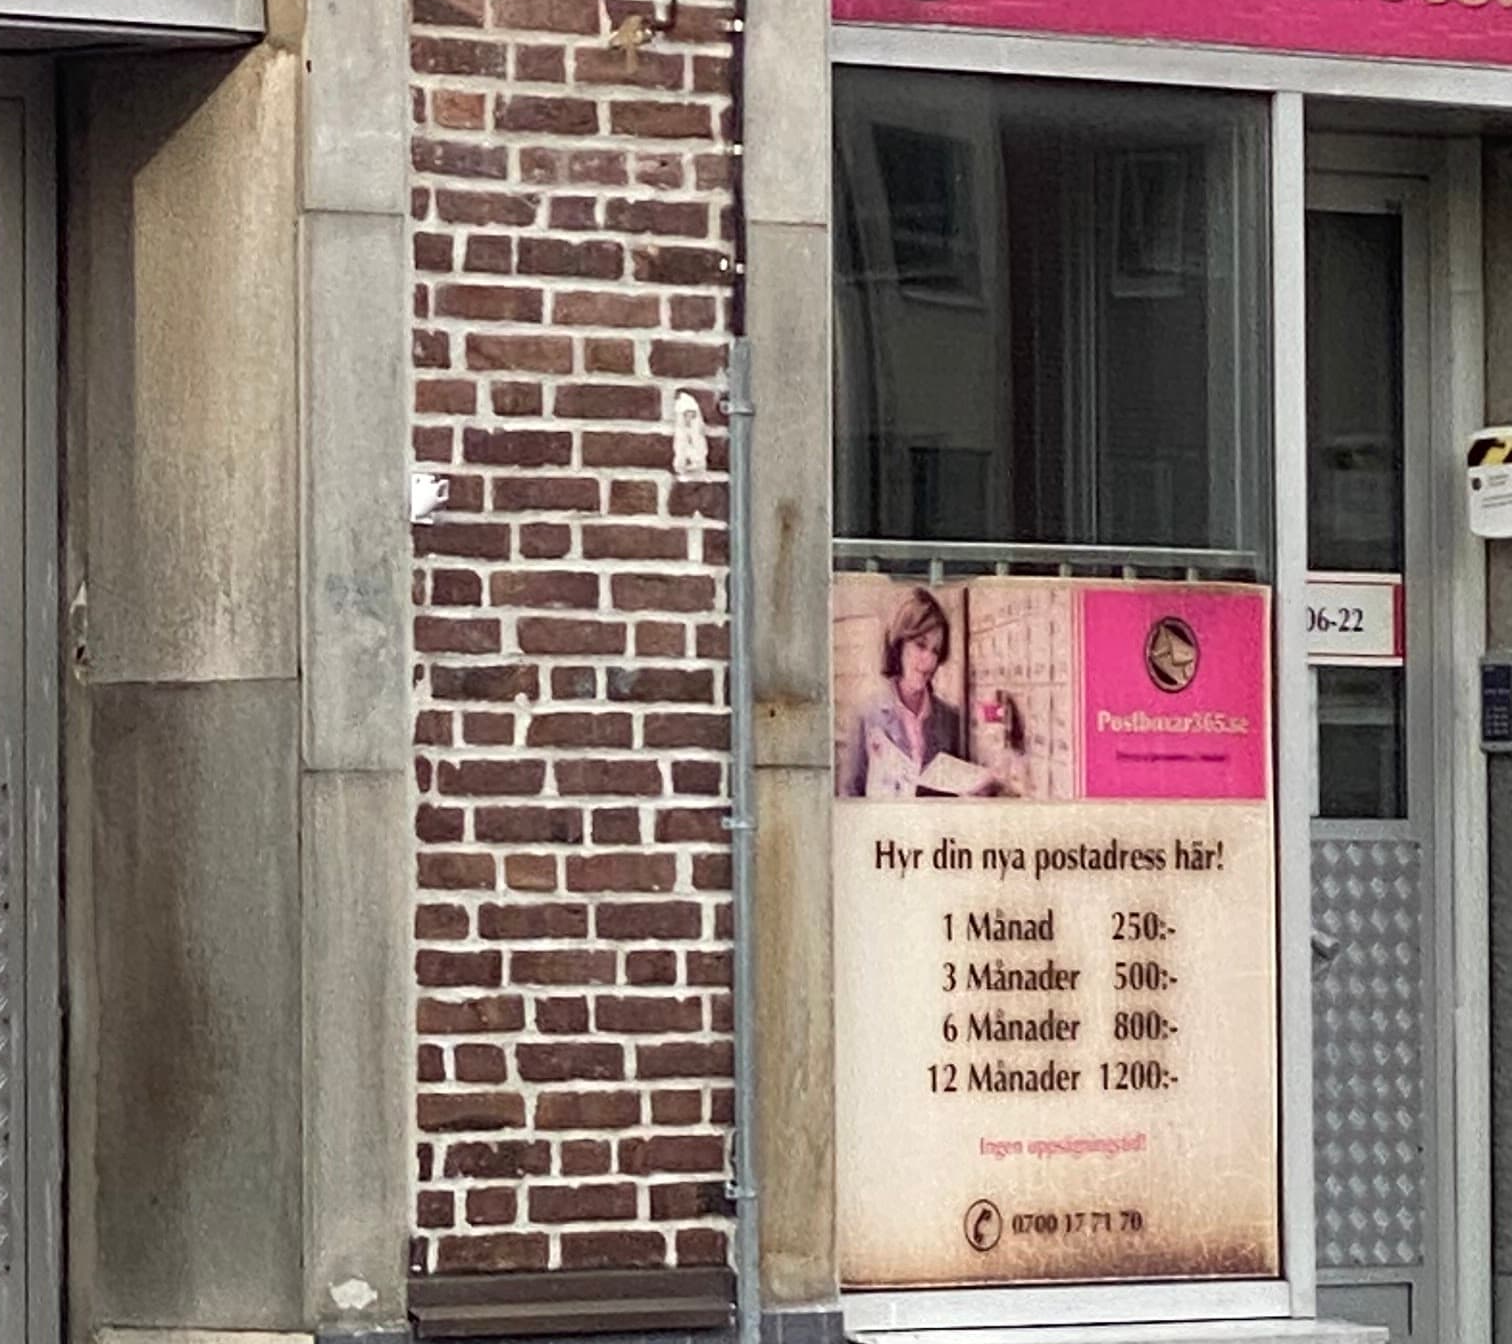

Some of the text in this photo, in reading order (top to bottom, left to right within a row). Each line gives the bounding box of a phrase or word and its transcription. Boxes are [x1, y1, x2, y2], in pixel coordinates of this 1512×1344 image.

[874, 838, 1225, 880] Hyr din nya postadress här!
[943, 908, 1176, 941] 1 Månad 250:-
[942, 958, 1178, 992] 3 Månader 500:-
[943, 1008, 1178, 1042] 6 Månader 800:-
[927, 1059, 1178, 1093] 12 Månader 1200:-
[1012, 1213, 1058, 1234] 0700
[1120, 1210, 1143, 1232] 70
